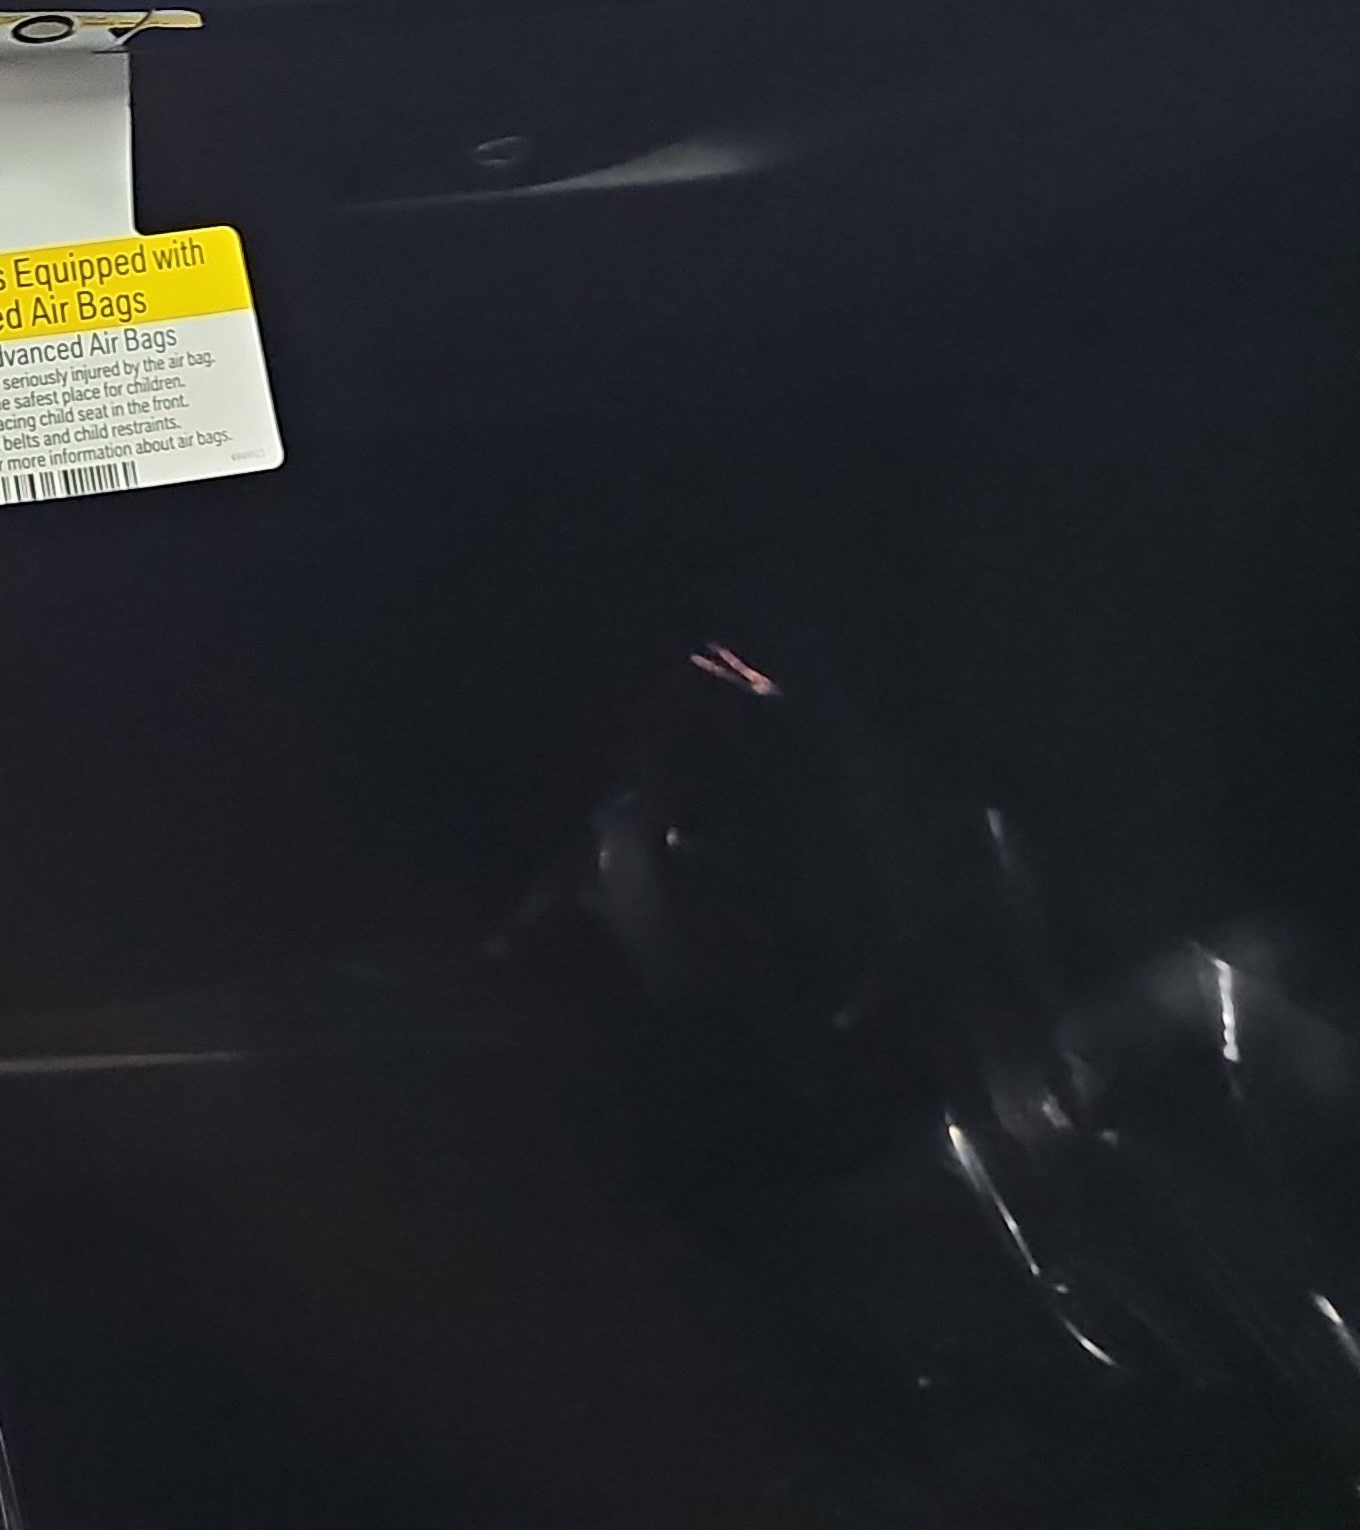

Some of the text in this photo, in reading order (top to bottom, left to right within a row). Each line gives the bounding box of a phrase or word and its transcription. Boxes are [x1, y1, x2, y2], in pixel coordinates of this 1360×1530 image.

[13, 244, 146, 291] Equipped
[153, 237, 205, 270] with
[31, 295, 69, 326] Air
[77, 290, 147, 322] Bags
[89, 331, 119, 356] Air
[124, 328, 177, 353] Bags
[3, 368, 68, 390] seriously
[71, 363, 120, 384] injured
[123, 361, 140, 377] by
[143, 357, 165, 372] the
[168, 354, 184, 368] air
[186, 351, 216, 368] bag.
[14, 389, 59, 409] safest
[62, 386, 100, 408] place
[104, 382, 123, 397] for
[127, 375, 186, 393] children.
[39, 408, 75, 426] child
[78, 404, 109, 421] seat
[112, 402, 124, 416] in
[127, 400, 150, 414] the
[152, 395, 189, 411] front.
[3, 434, 40, 451] belts
[43, 429, 71, 446] and
[74, 424, 109, 442] child
[112, 417, 182, 437] restraints.
[7, 455, 46, 470] more
[49, 442, 133, 466] information
[136, 436, 174, 454] about
[178, 434, 193, 449] air
[196, 430, 233, 447] bags.
